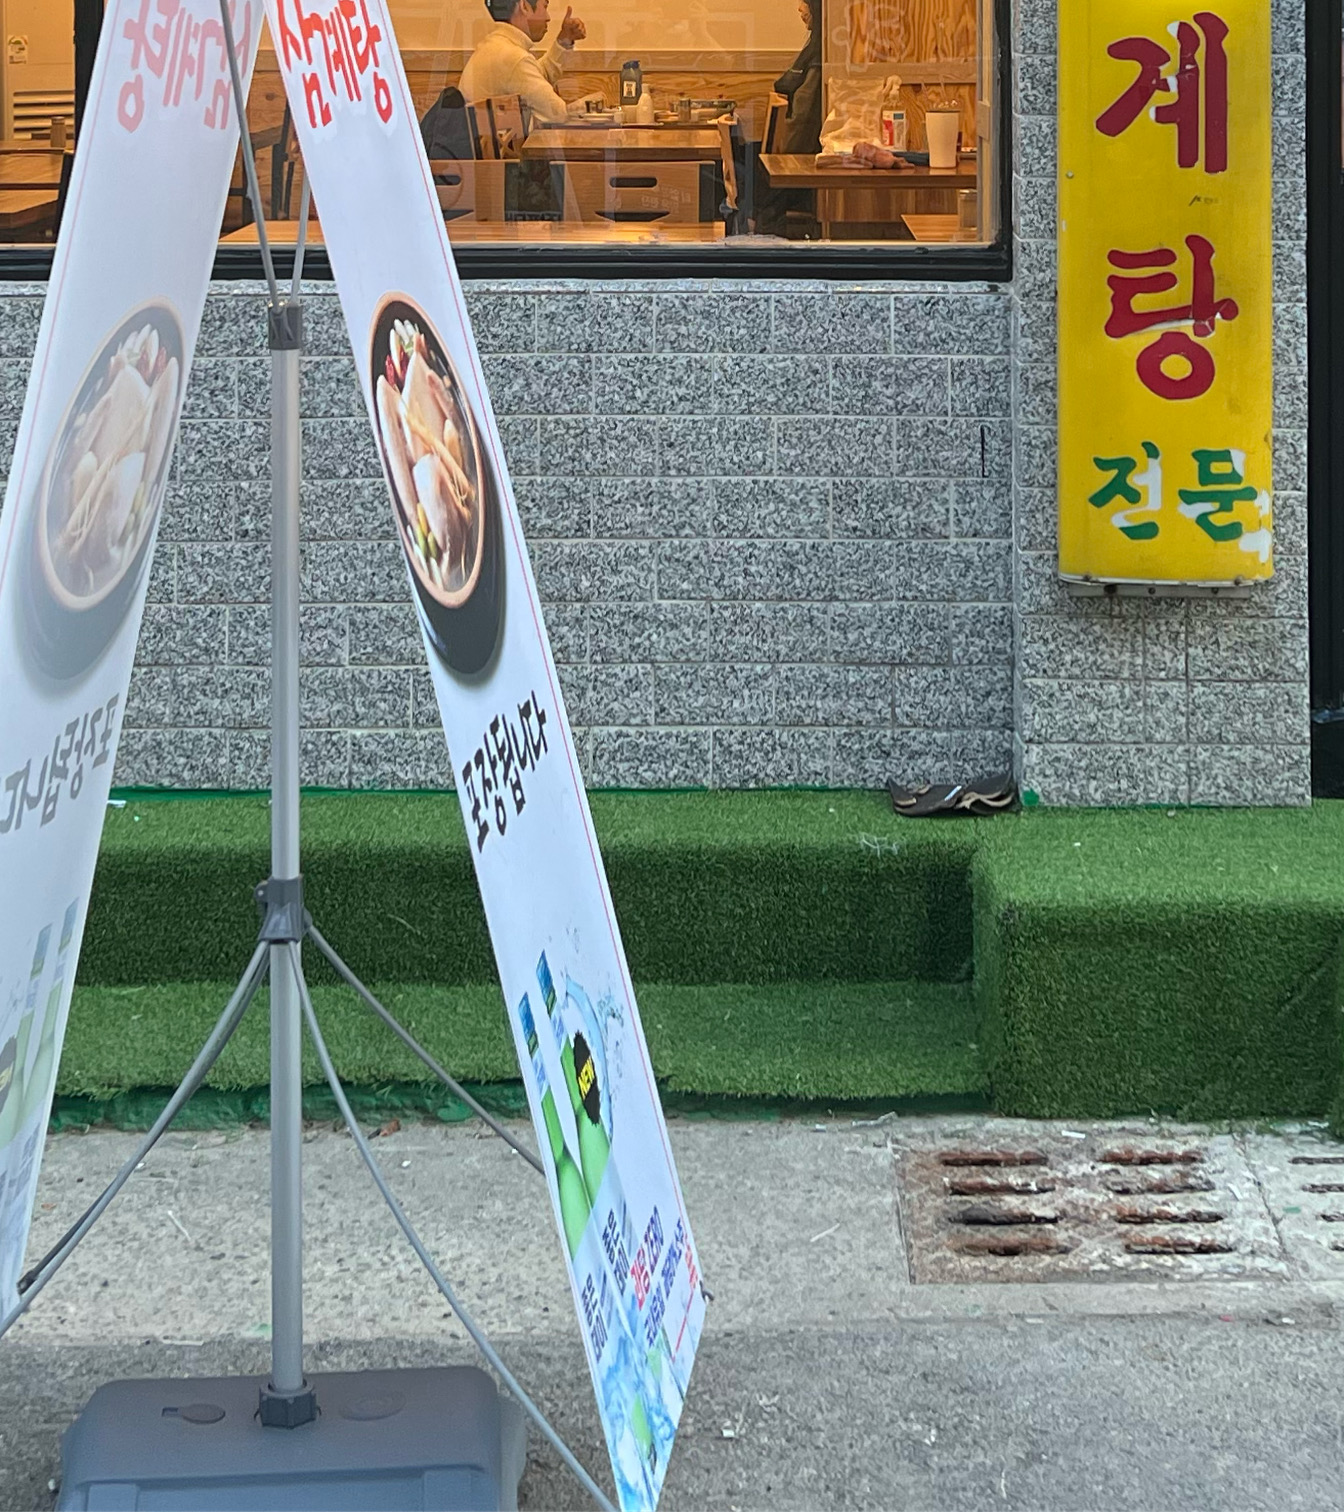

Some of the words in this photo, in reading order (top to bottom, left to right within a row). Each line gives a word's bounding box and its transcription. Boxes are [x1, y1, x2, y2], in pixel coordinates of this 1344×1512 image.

[1088, 441, 1258, 541] 전문
[462, 690, 548, 854] 포장됩니다
[578, 1055, 595, 1101] NEW
[643, 1204, 665, 1276] ZERO
